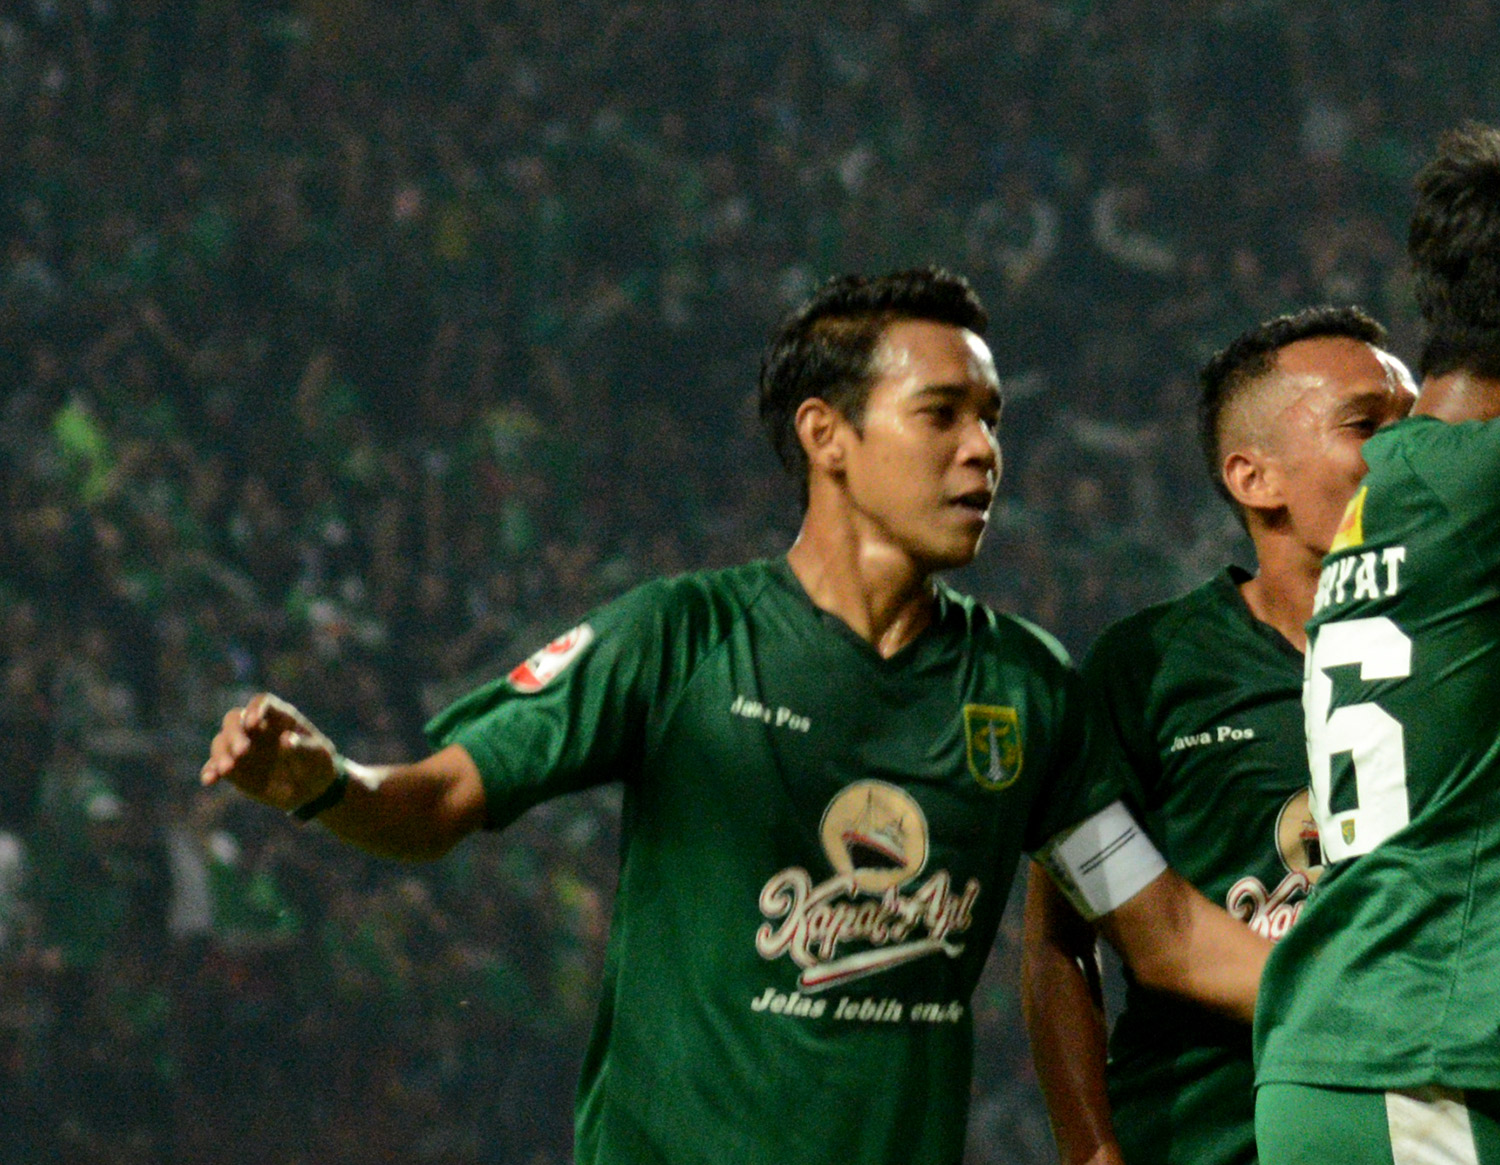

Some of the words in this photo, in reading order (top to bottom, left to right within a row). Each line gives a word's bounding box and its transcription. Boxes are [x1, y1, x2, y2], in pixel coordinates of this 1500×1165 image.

[1217, 726, 1254, 743] Pos
[1302, 615, 1412, 864] 6
[756, 866, 899, 968] Kapal
[751, 988, 827, 1019] Jelas
[833, 997, 904, 1021] lebih
